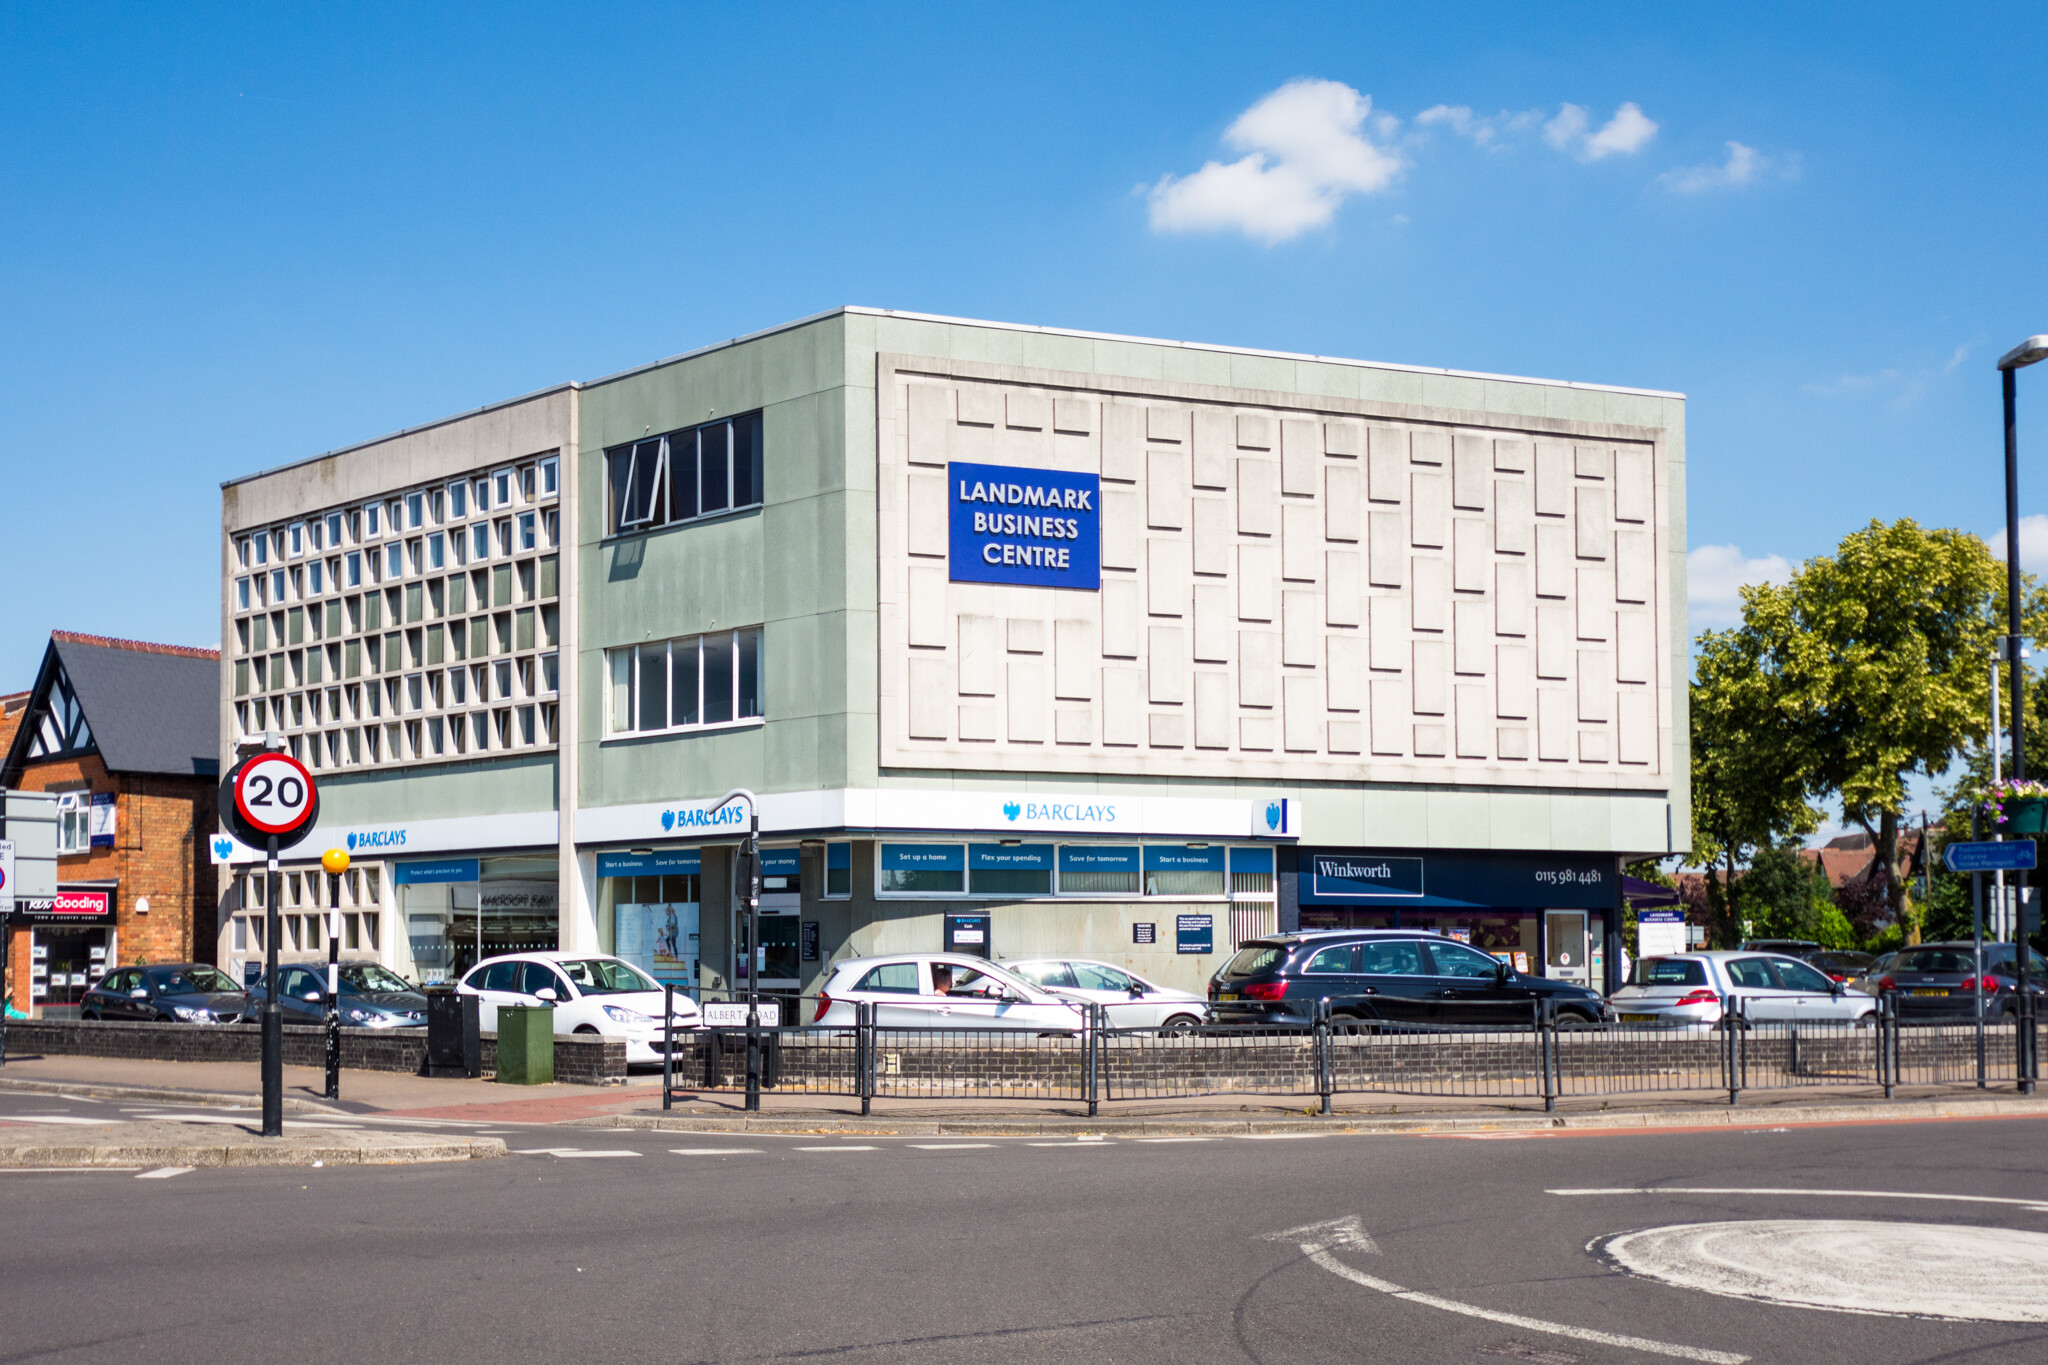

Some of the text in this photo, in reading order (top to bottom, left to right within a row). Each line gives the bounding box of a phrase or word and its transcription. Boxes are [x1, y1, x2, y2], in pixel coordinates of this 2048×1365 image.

[958, 480, 1092, 511] LANDMARK
[973, 512, 1079, 540] BUSINESS
[983, 543, 1070, 568] CENTRE
[249, 775, 304, 808] 20
[678, 806, 744, 828] BARCLAYS
[1026, 803, 1116, 822] BARCLAYS
[359, 829, 407, 848] BARCLAYS
[765, 859, 777, 867] your
[1012, 855, 1041, 863] spending
[1086, 855, 1096, 863] for
[1319, 861, 1391, 878] Winkworth
[1535, 869, 1601, 885] 0115 981 4481
[54, 896, 104, 912] Gooding
[708, 1010, 743, 1020] ALBERT
